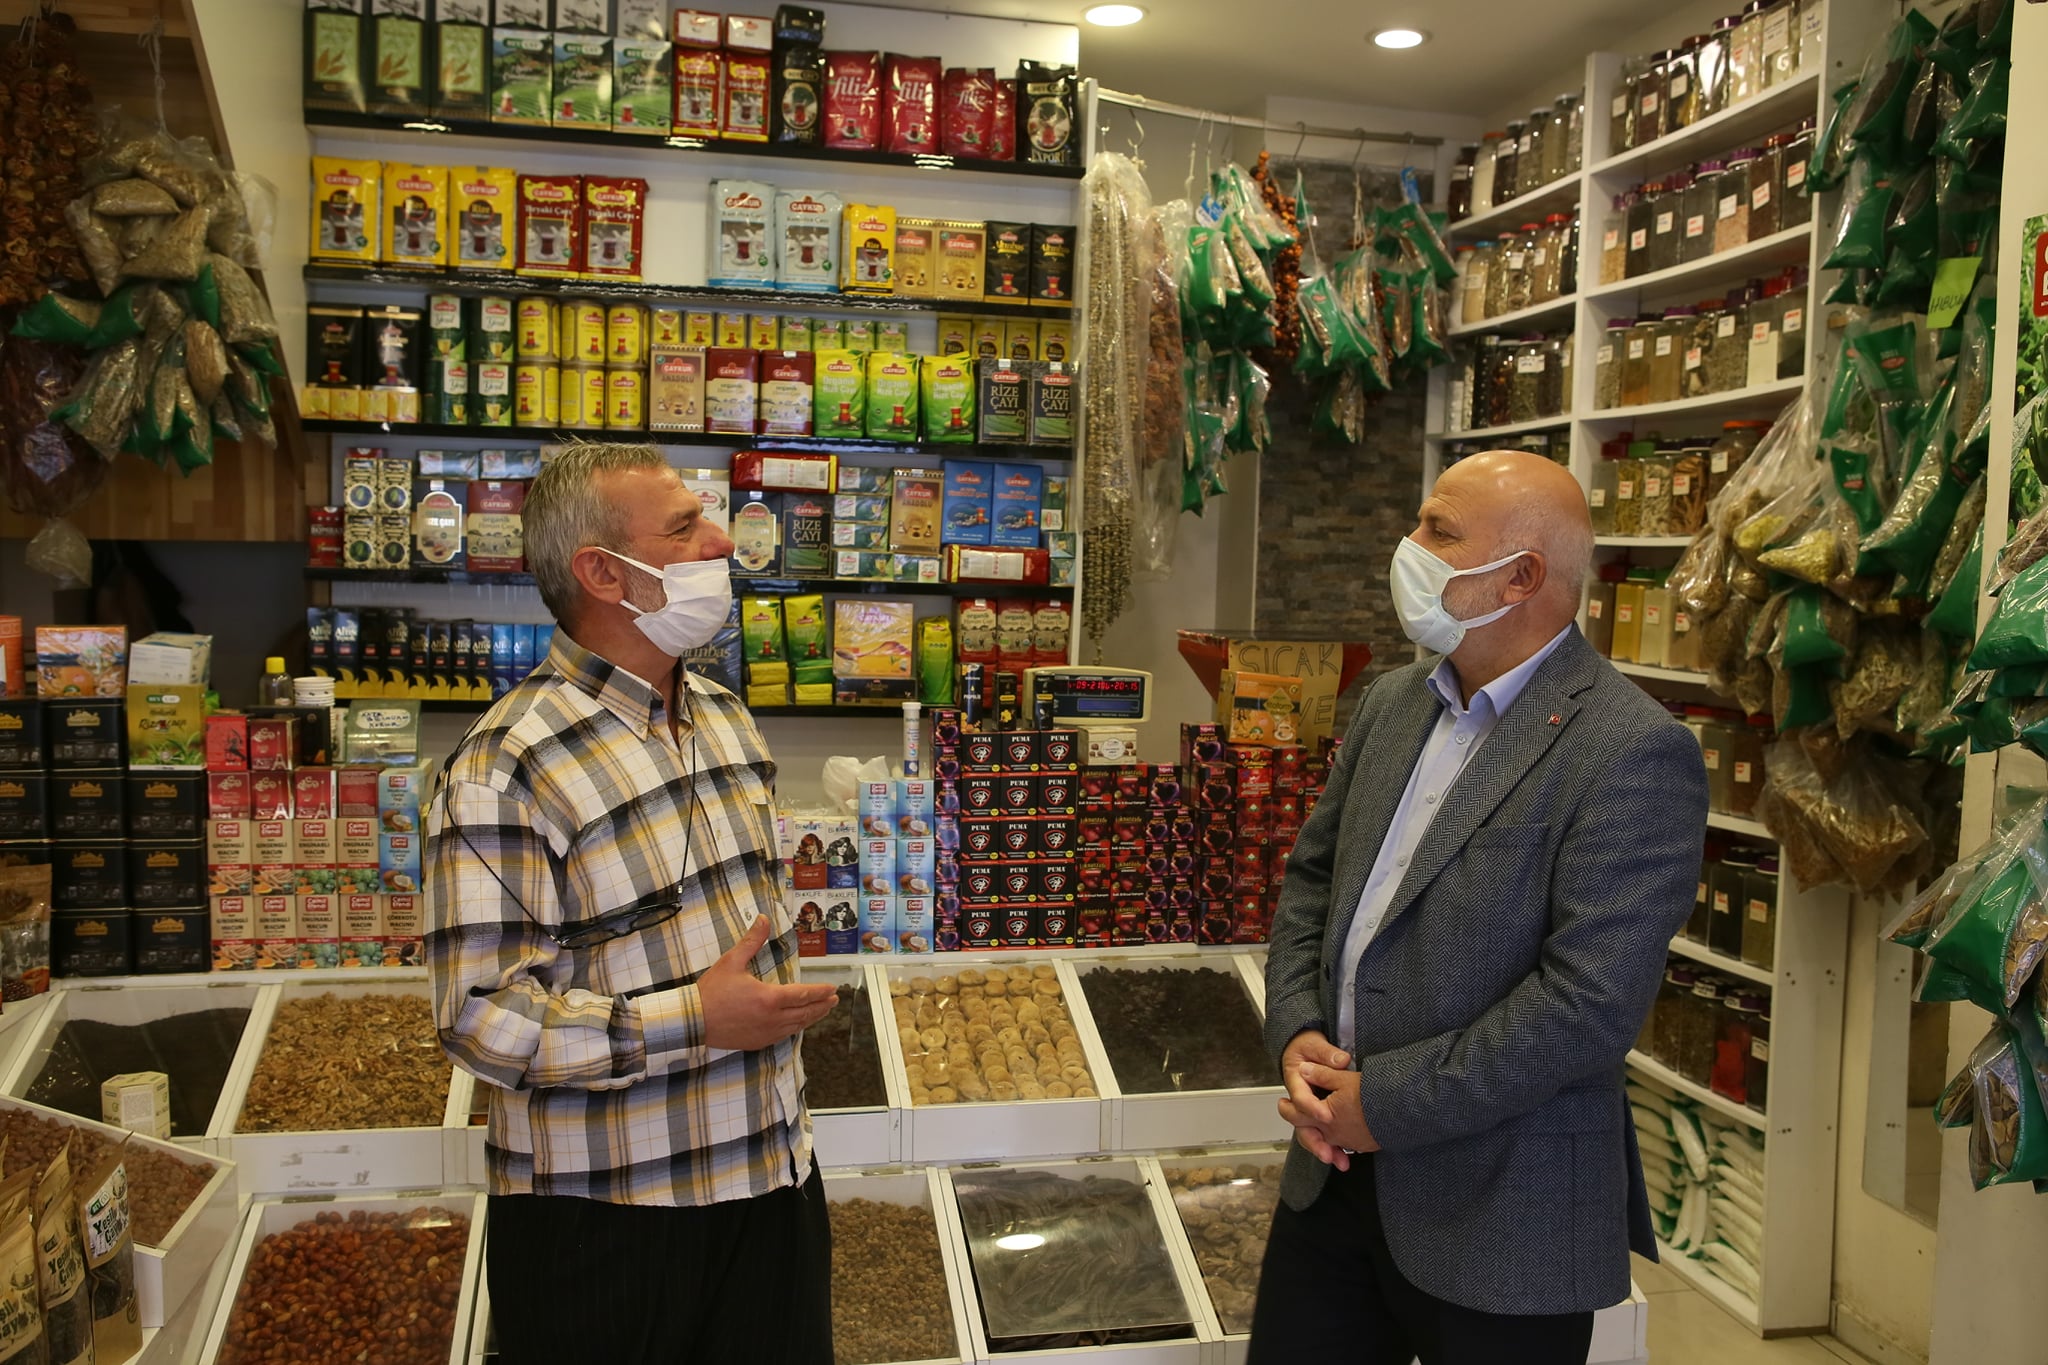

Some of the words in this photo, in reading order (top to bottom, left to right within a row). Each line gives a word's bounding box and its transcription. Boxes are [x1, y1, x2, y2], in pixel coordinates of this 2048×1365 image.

[991, 384, 1020, 397] RİZE
[1042, 386, 1070, 400] RİZE
[990, 396, 1018, 410] ÇAYI
[1041, 399, 1069, 412] ÇAYI
[793, 518, 822, 531] RİZE
[792, 530, 822, 544] ÇAYI
[1238, 644, 1339, 678] SICAK
